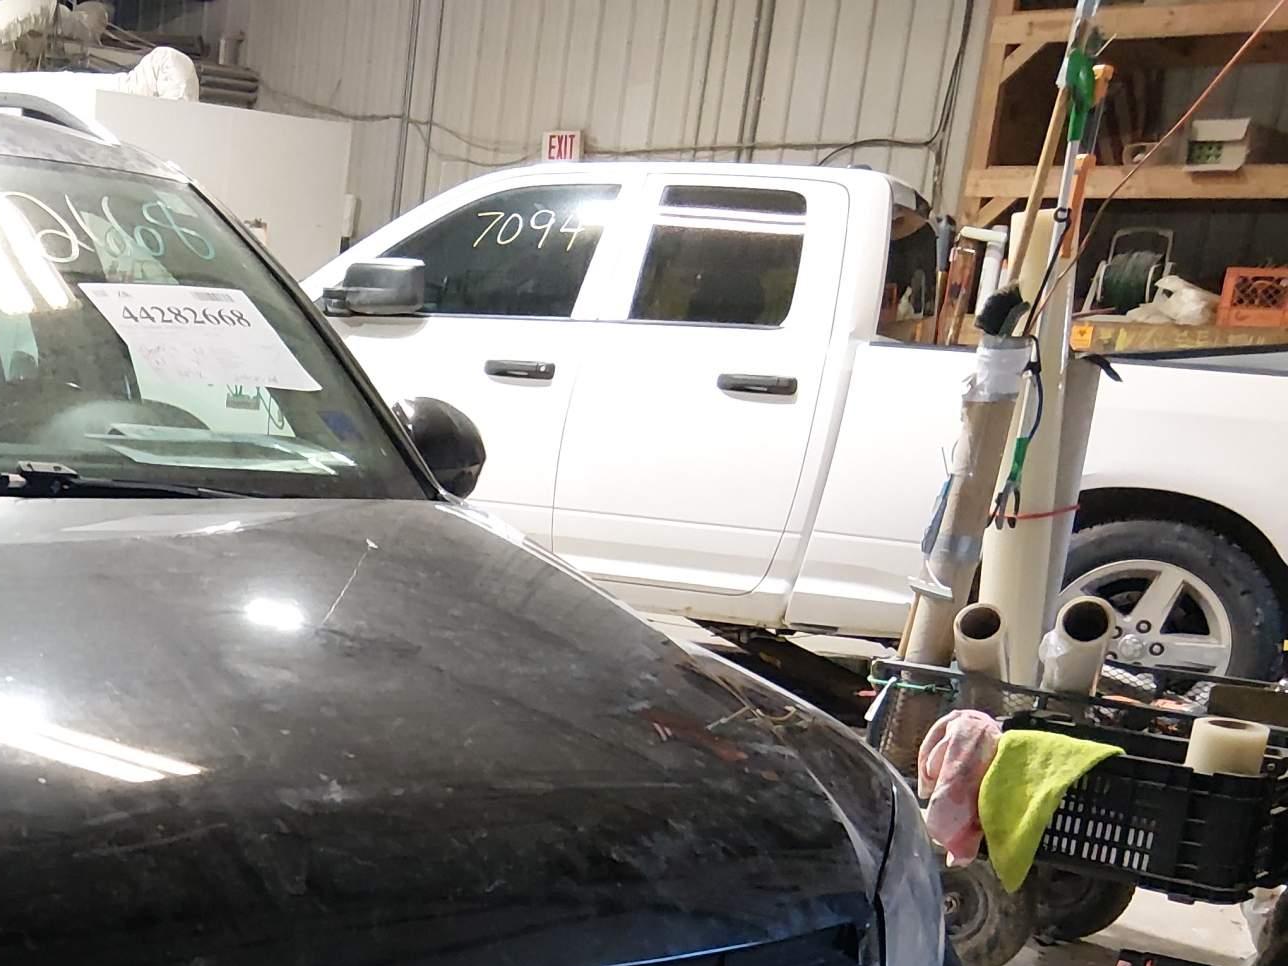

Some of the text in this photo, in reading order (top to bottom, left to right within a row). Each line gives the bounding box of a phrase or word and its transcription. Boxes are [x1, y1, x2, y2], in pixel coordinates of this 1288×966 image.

[547, 134, 576, 160] EXIT
[472, 208, 586, 252] 7094
[121, 305, 252, 328] 44282668
